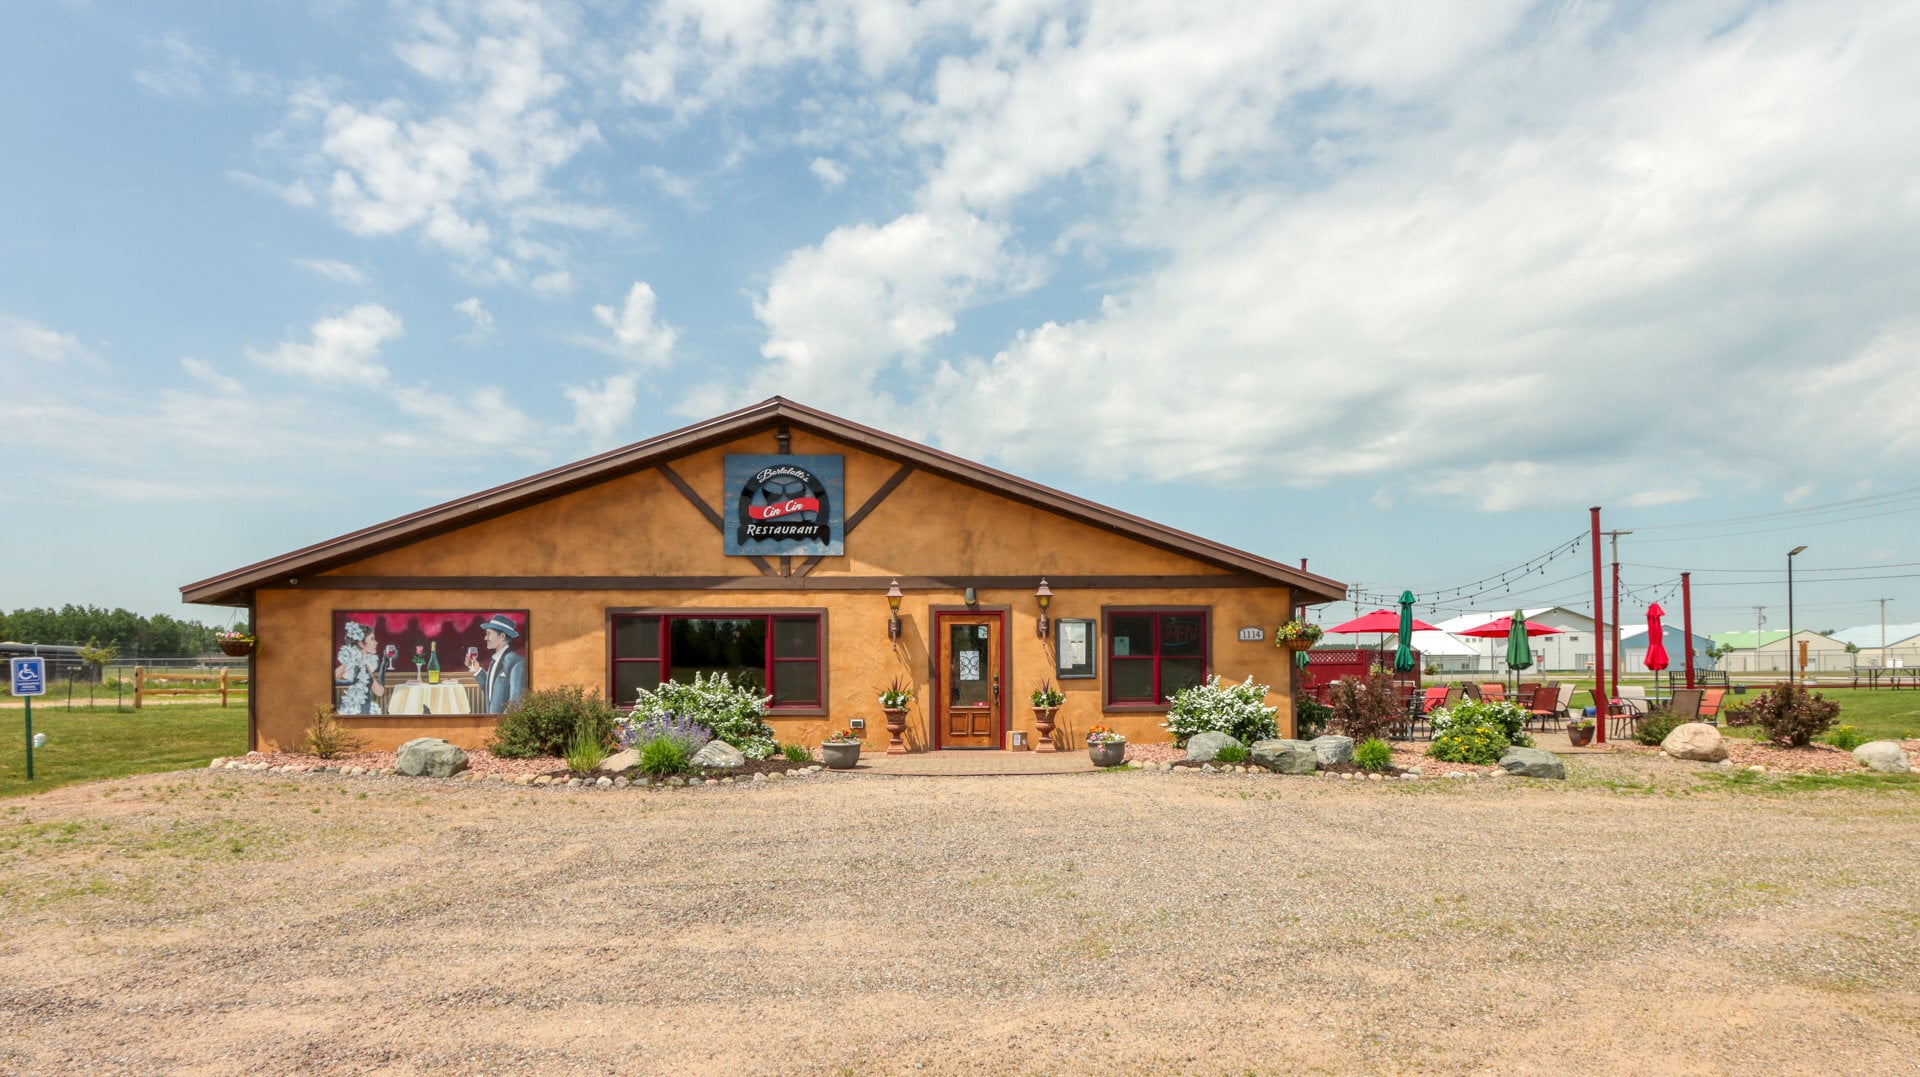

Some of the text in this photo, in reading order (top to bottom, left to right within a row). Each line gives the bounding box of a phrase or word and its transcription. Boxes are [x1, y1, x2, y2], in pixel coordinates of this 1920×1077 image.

[763, 500, 803, 518] Cin Cin
[746, 524, 819, 536] RESTAURANT
[1242, 630, 1260, 639] 1114
